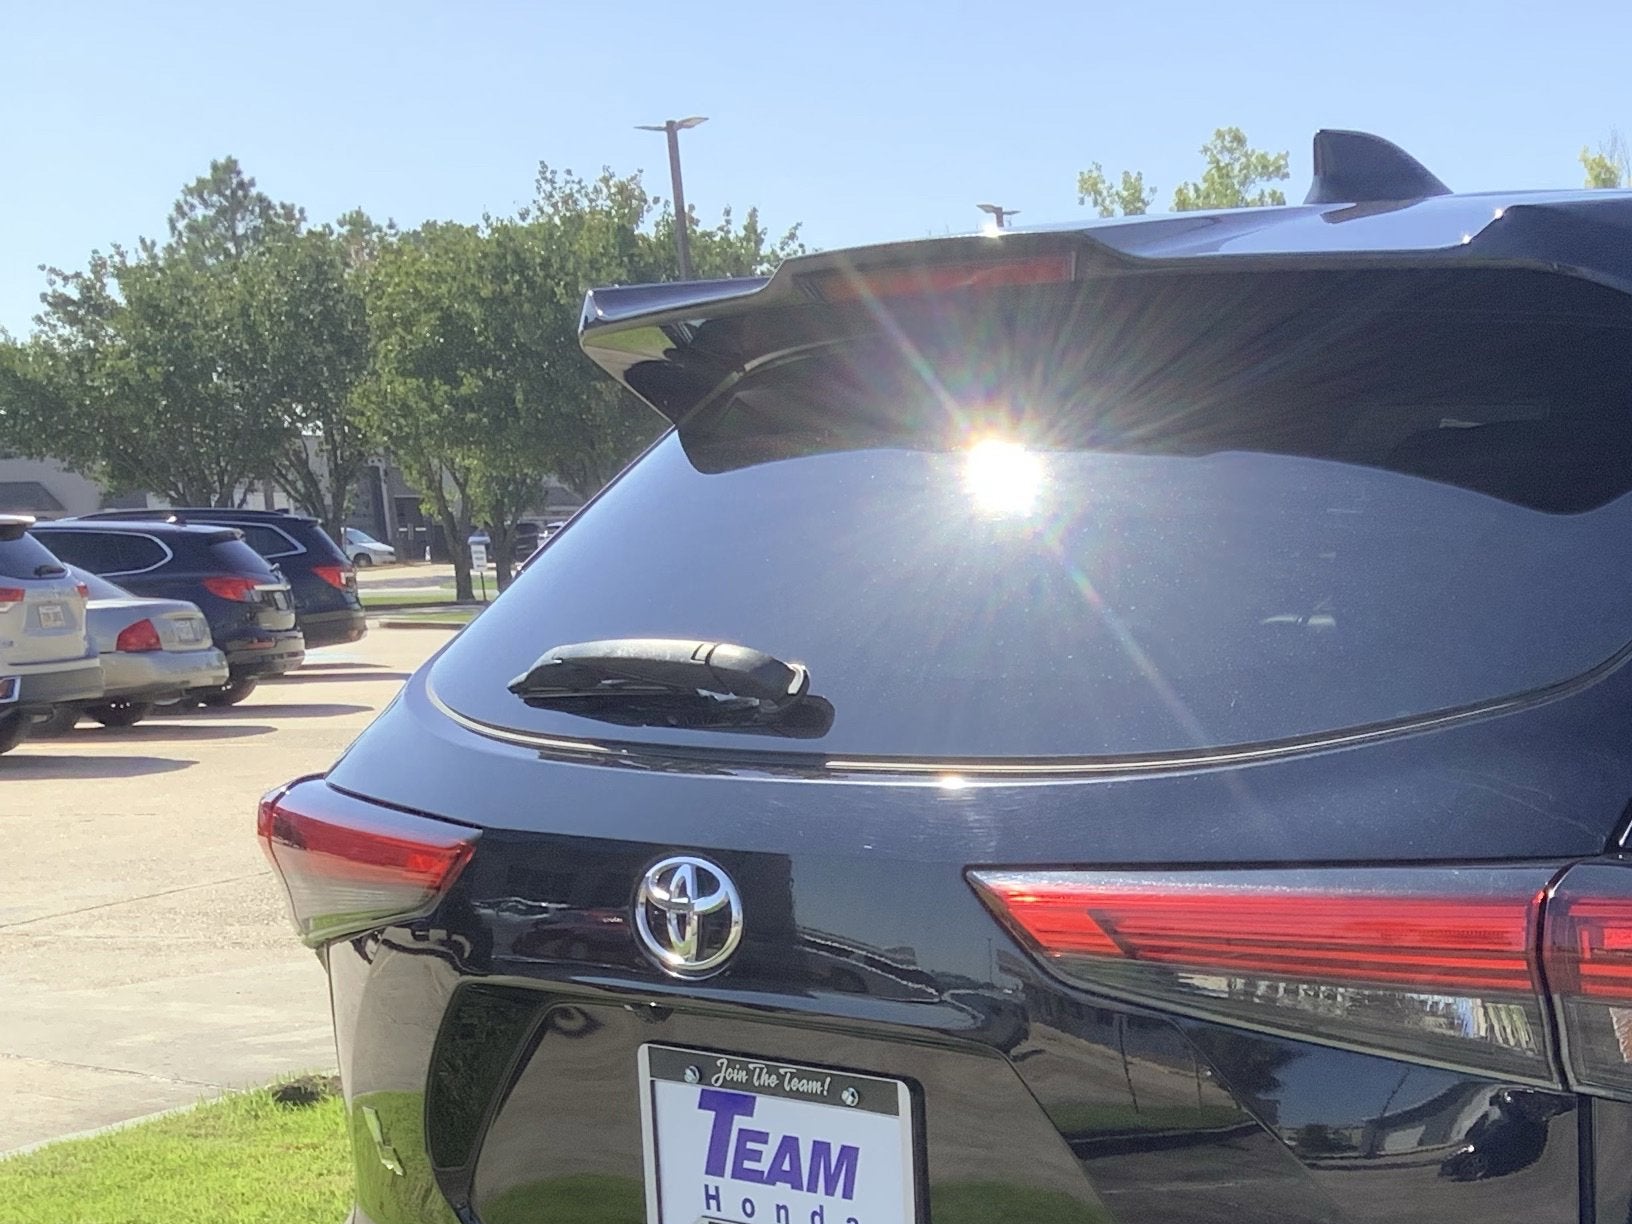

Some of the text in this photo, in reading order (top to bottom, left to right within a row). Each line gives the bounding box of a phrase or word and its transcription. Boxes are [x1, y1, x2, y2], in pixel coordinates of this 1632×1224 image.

[711, 1058, 831, 1096] Join The Team!
[697, 1088, 860, 1201] TEAM
